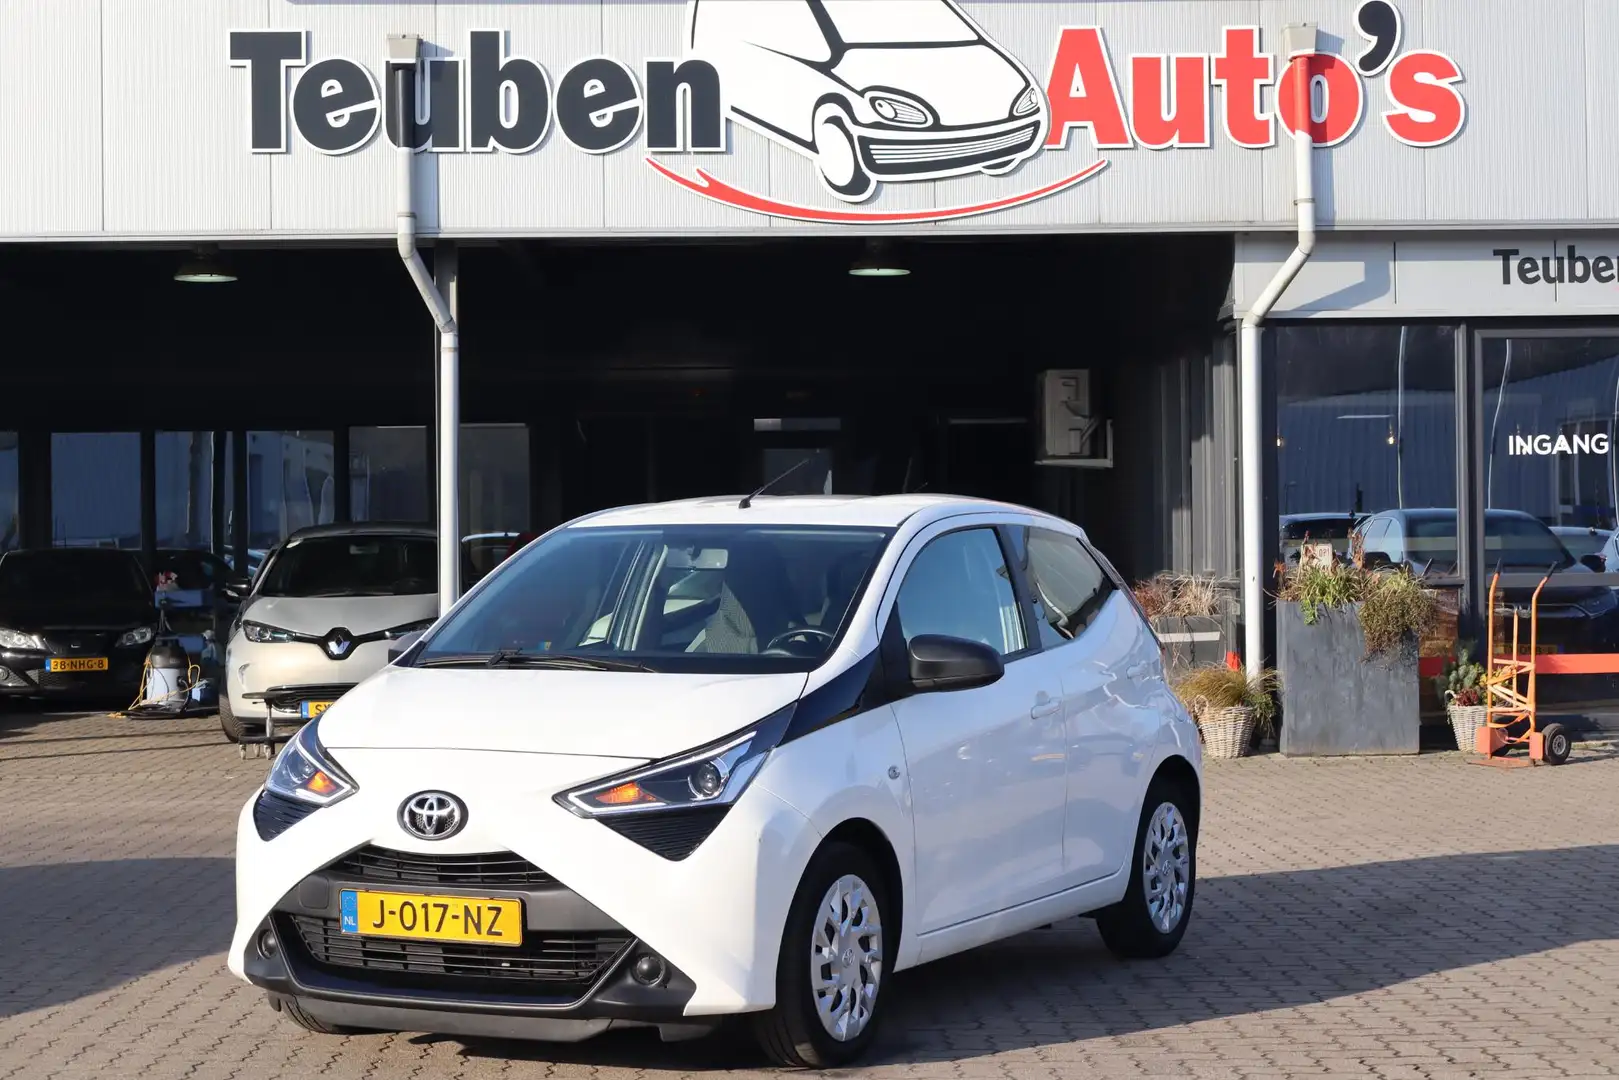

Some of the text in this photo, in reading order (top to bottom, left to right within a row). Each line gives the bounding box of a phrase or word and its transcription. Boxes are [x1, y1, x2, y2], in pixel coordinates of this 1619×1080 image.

[229, 1, 1465, 153] Teuben Auto's
[1492, 244, 1619, 285] Teube
[1508, 433, 1609, 455] INGANG
[52, 659, 105, 670] 38-NHG-8
[344, 899, 503, 937] NL J-017-NZ
